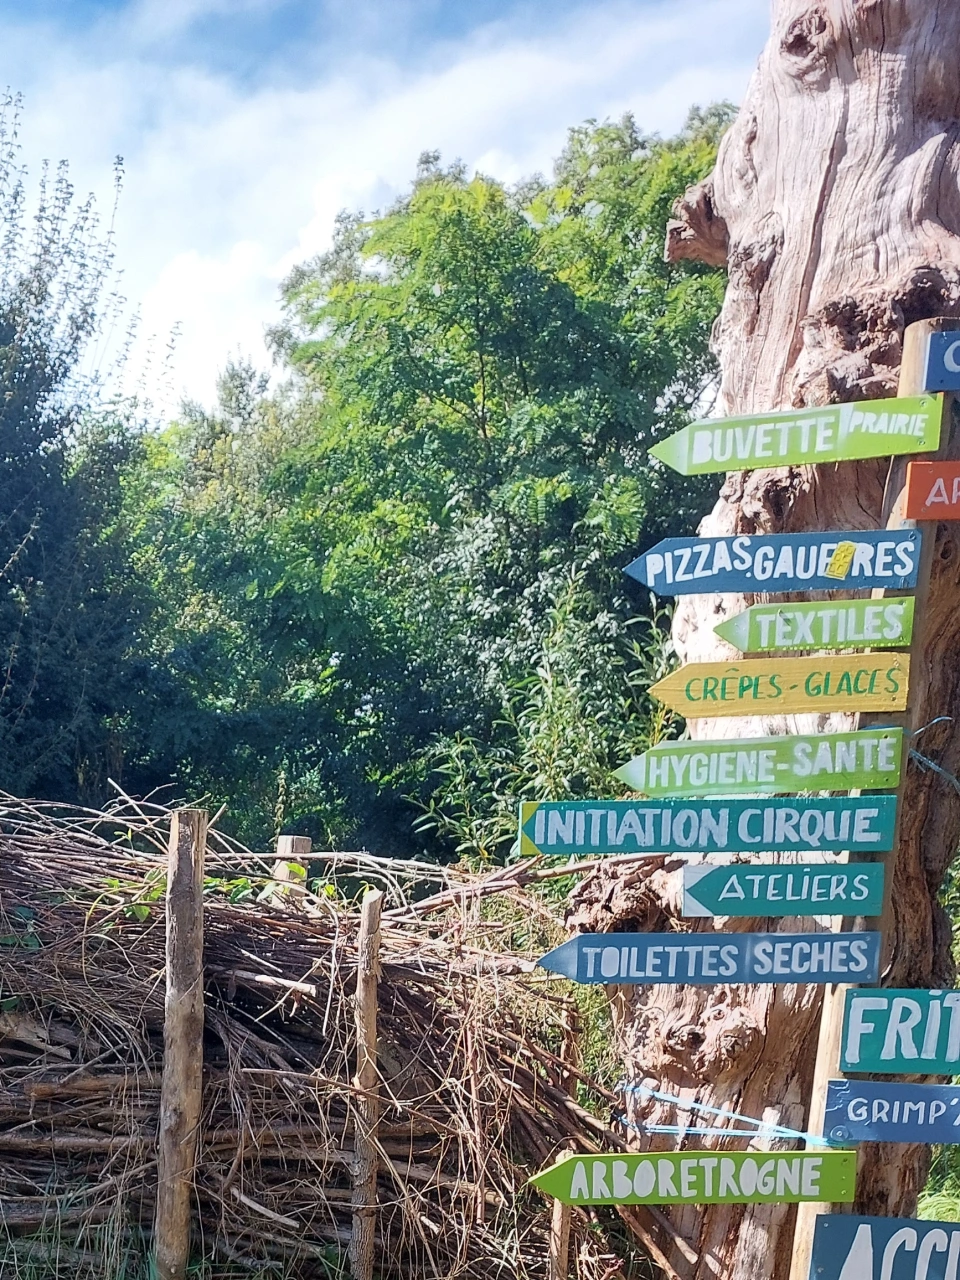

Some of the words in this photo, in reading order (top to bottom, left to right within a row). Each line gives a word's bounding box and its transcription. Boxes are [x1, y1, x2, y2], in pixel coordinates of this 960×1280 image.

[692, 416, 835, 465] BUVETTE
[848, 410, 929, 437] PRAIRIE
[756, 605, 904, 647] TEXTILES
[685, 667, 783, 702] CRÊPES
[804, 668, 900, 698] GLACES
[534, 807, 731, 848] INITIATION
[738, 807, 882, 848] CIRQUE
[718, 868, 870, 902] ATELIERS
[582, 944, 738, 979] TOILETTES
[753, 940, 868, 975] SECHES
[569, 1157, 824, 1200] ARBORETROGNE
